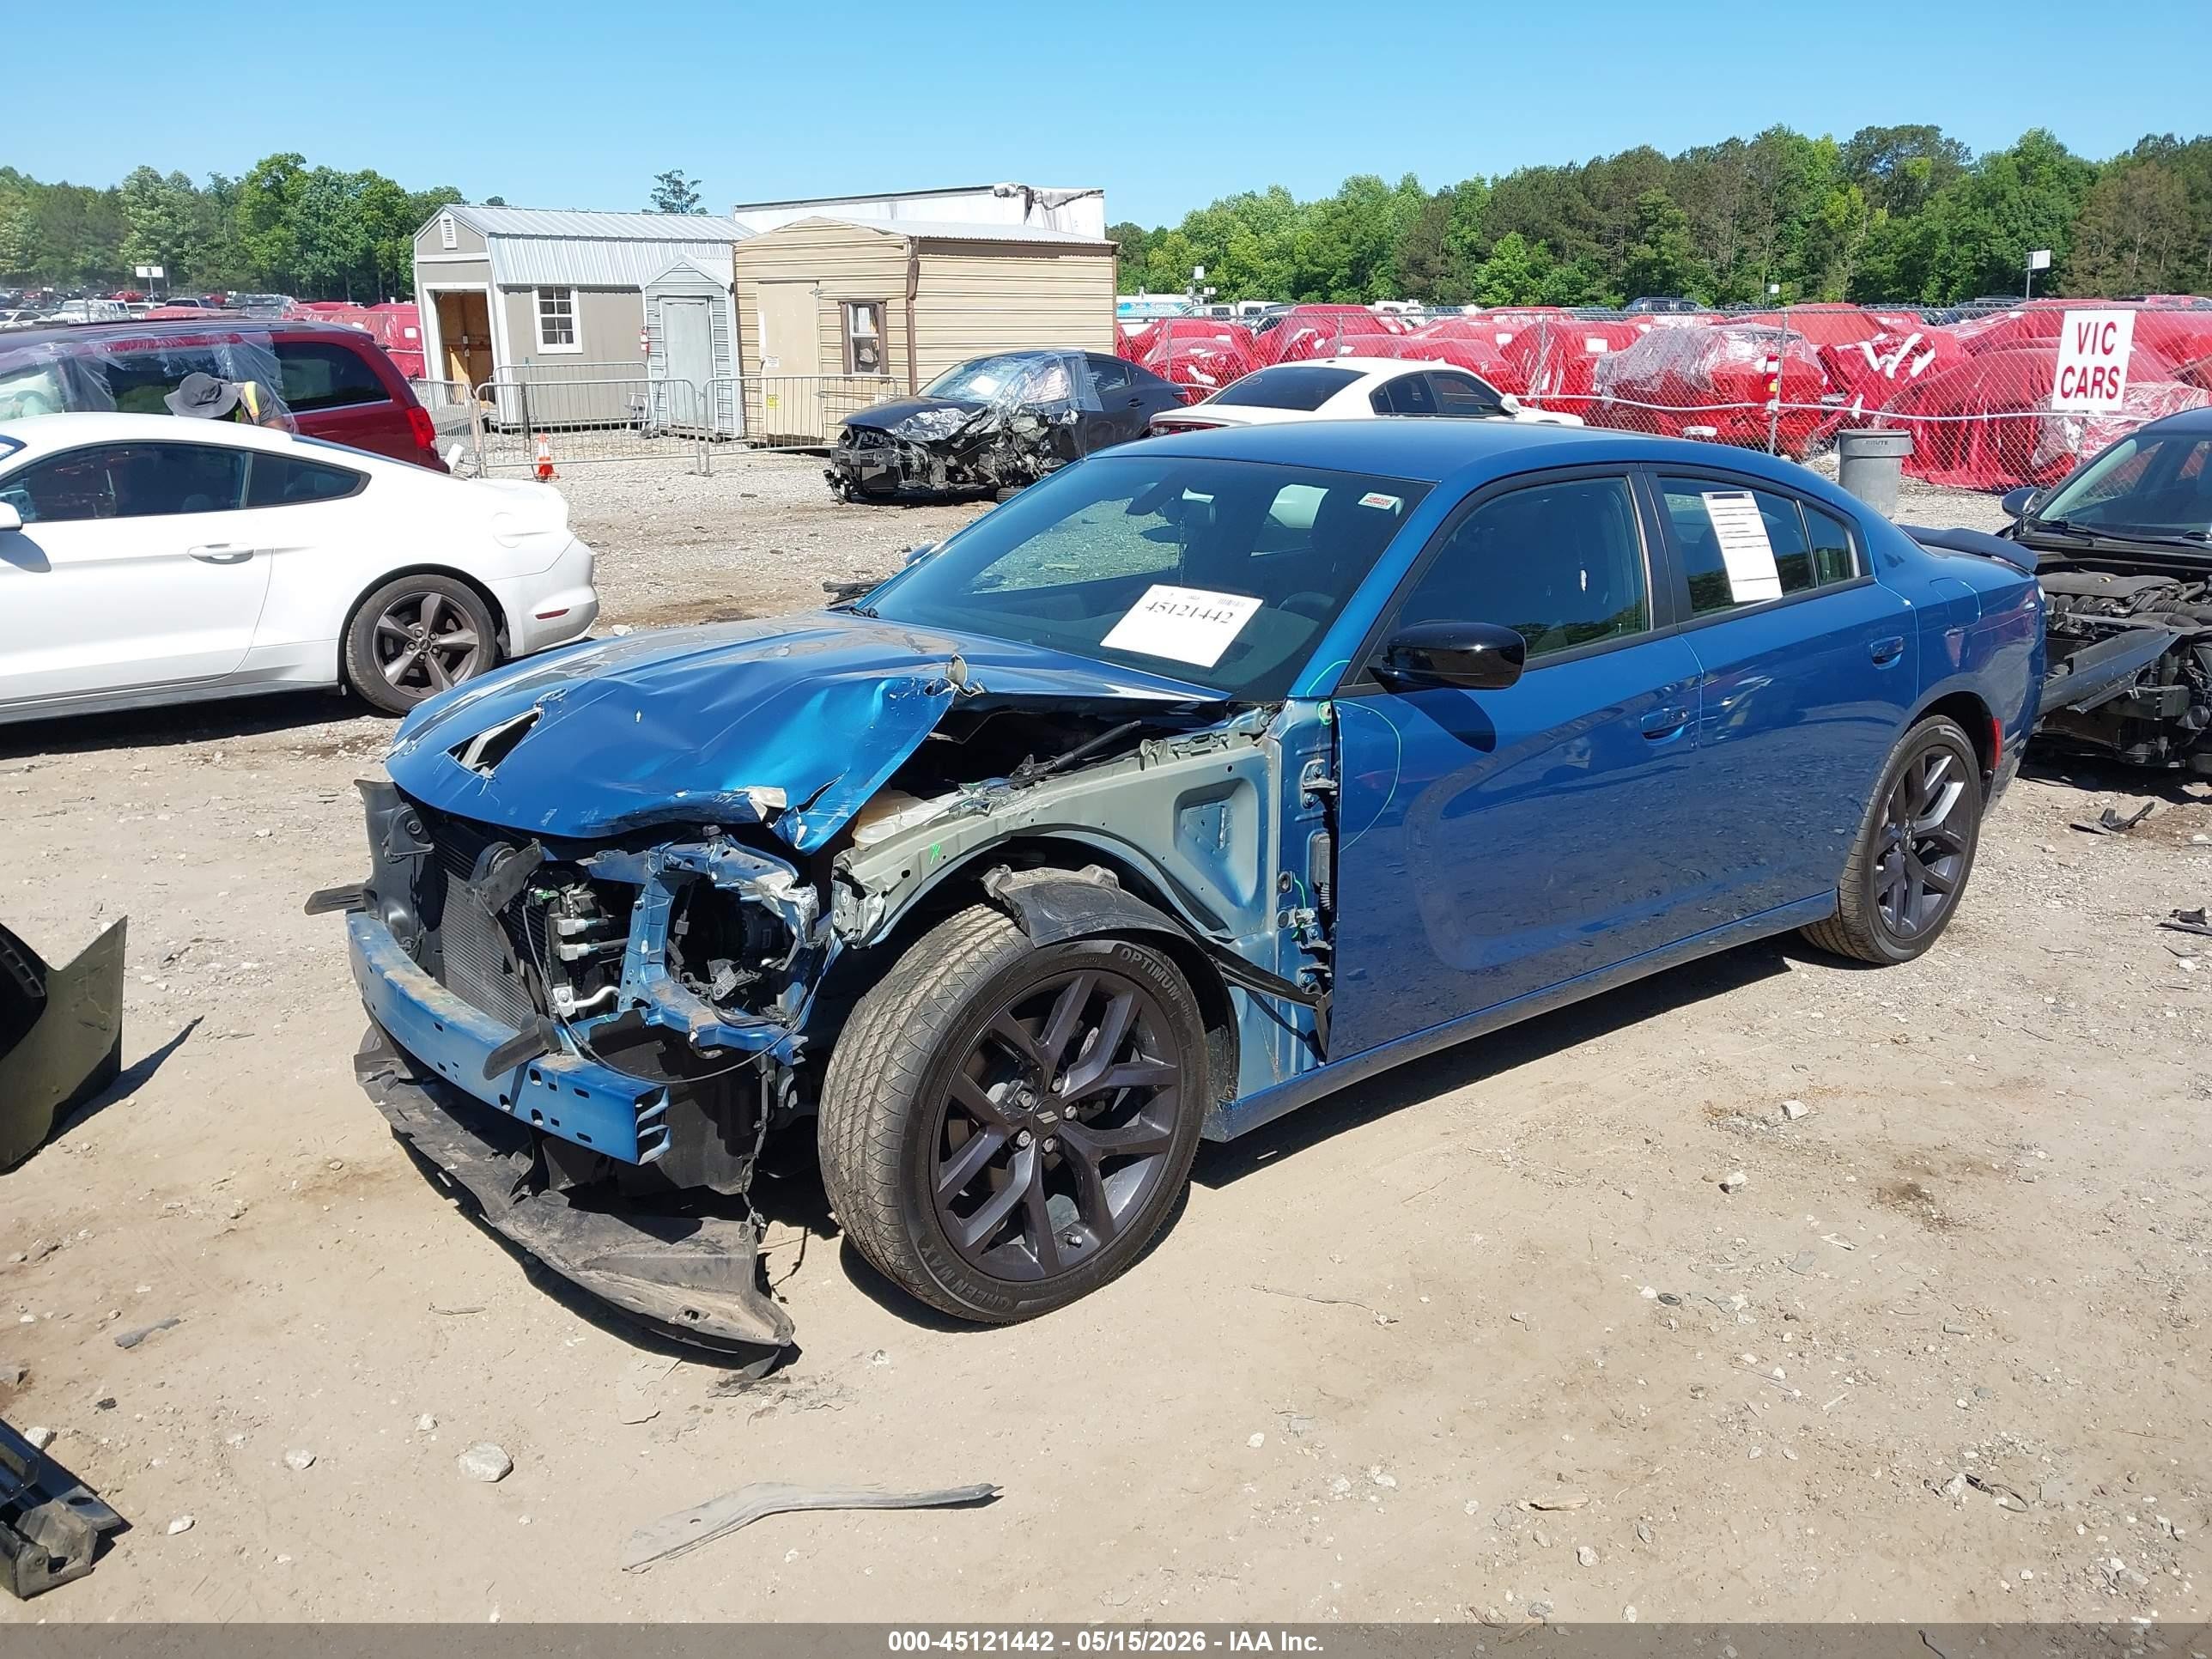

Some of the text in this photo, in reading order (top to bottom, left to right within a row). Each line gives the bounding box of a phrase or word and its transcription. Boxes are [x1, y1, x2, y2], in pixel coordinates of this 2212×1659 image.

[2078, 321, 2117, 355] VIC
[2061, 366, 2120, 399] CARS
[1146, 602, 1234, 623] 45121442
[1120, 947, 1182, 1000] OPTIMUM
